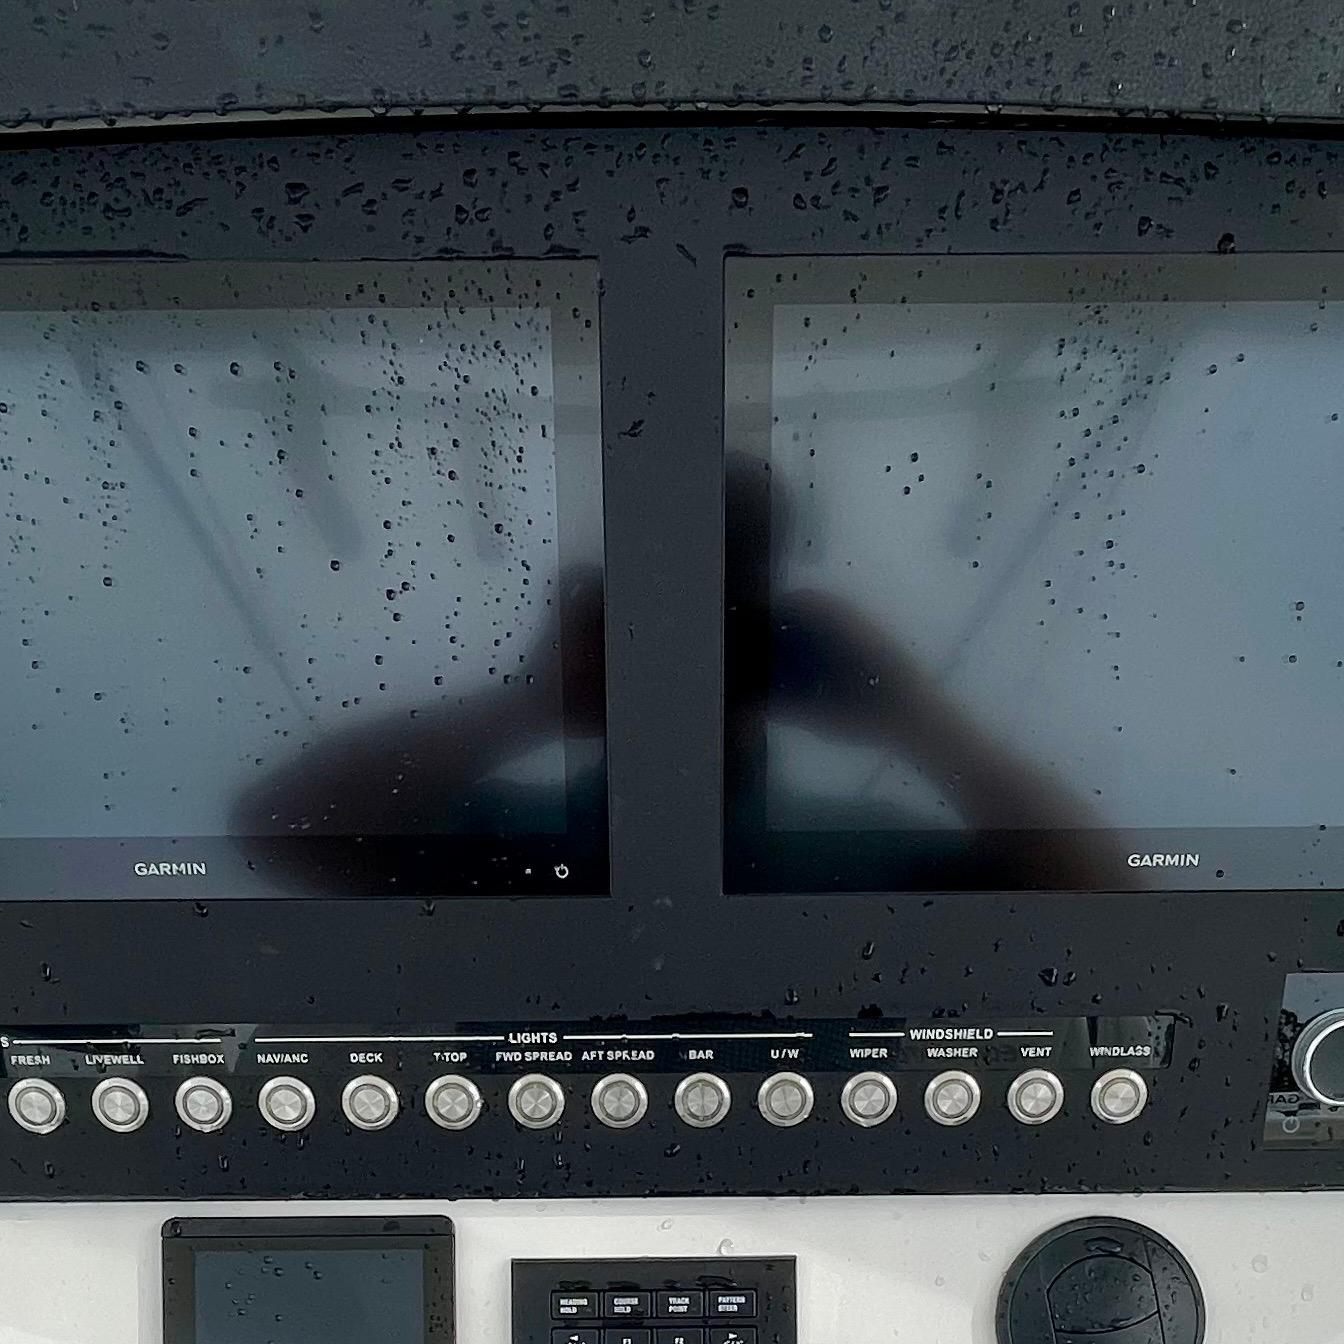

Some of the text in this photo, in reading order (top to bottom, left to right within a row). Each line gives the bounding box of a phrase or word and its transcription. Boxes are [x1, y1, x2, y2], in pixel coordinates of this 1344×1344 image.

[1128, 853, 1200, 868] GARMIN
[134, 862, 206, 876] GARMIN
[508, 1031, 558, 1045] LIGHTS
[909, 1027, 994, 1041] WINDSHIELD
[349, 1052, 384, 1064] DECK
[434, 1051, 468, 1064] T-TOP
[496, 1050, 573, 1062] FWD SPREAD
[581, 1049, 655, 1062] AFT SPREAD
[688, 1049, 715, 1061] BAR
[850, 1047, 888, 1060] WIPER
[926, 1047, 978, 1059] WASHER
[1020, 1046, 1052, 1058] VENT
[1089, 1046, 1151, 1058] WINDLASS
[10, 1054, 51, 1066] FRESH
[84, 1054, 145, 1066] LIVEWELL
[172, 1052, 225, 1066] FISHBOX
[256, 1052, 310, 1065] NAV/ANC
[675, 1337, 684, 1344] F2
